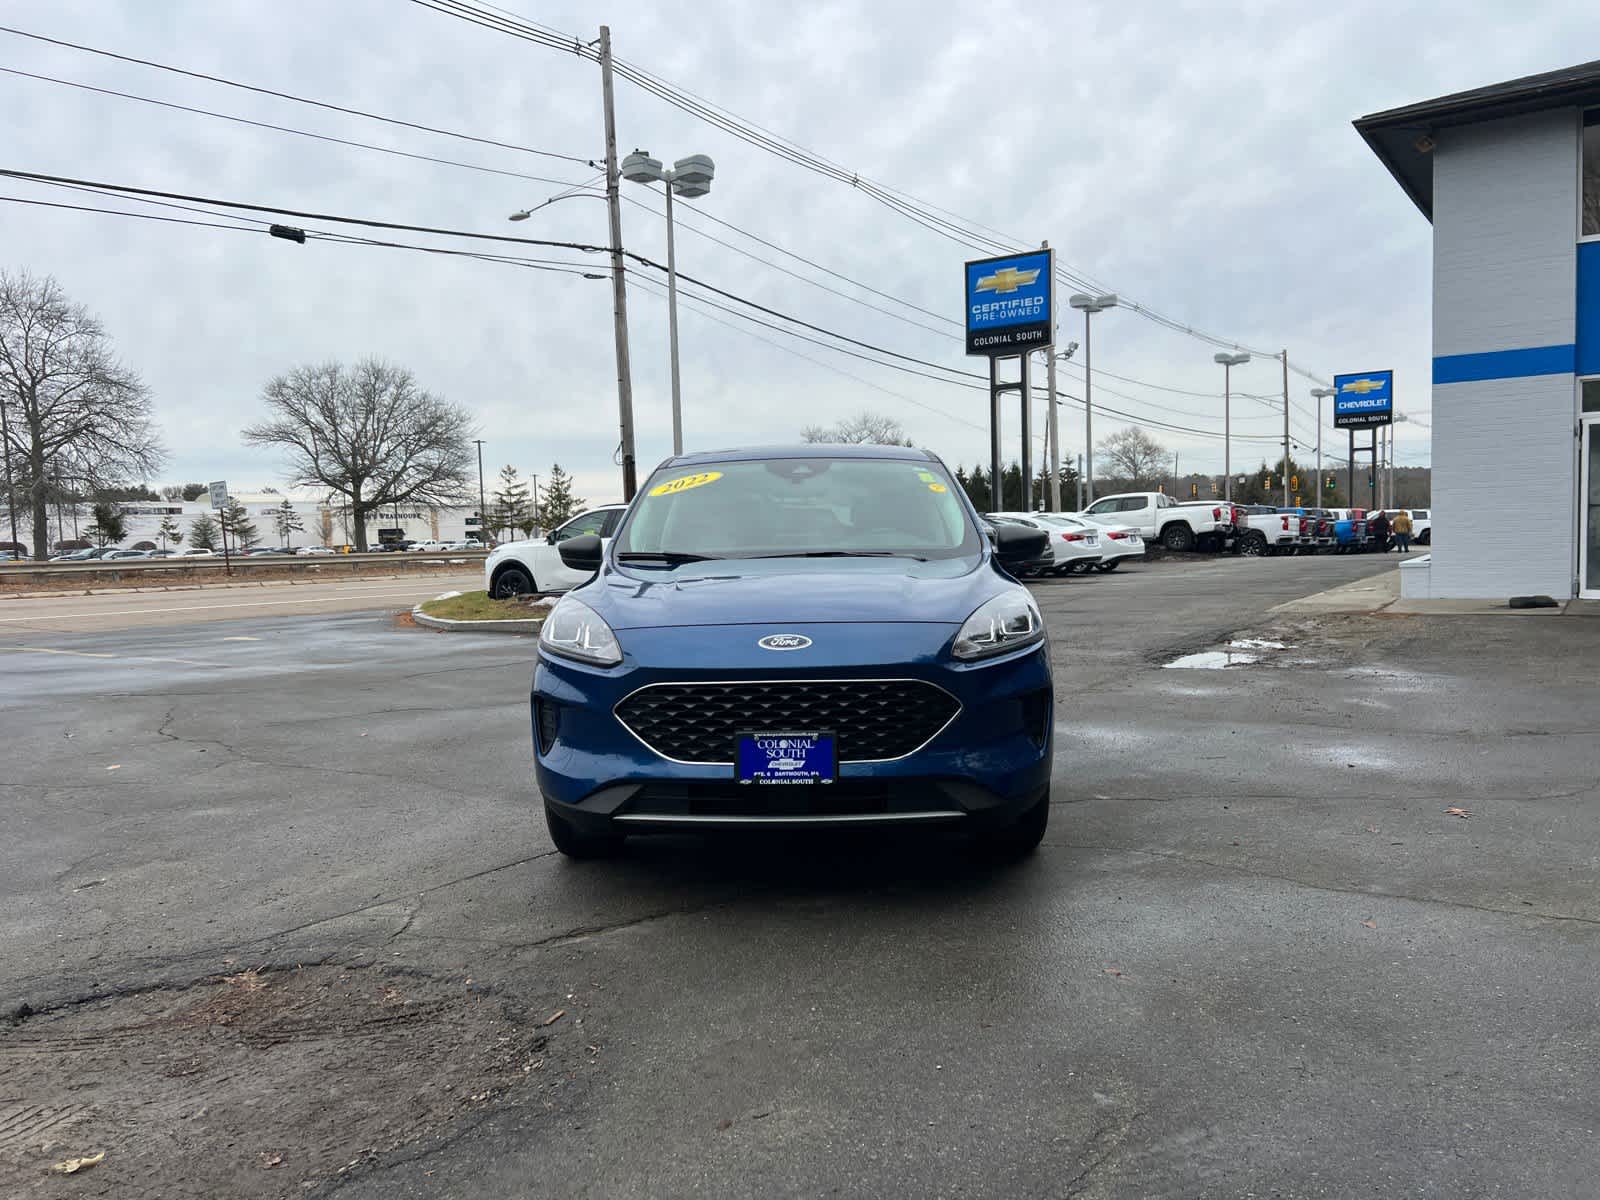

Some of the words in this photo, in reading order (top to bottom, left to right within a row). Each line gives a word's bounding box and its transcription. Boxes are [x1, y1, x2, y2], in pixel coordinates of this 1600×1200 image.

[972, 296, 1044, 314] CERTIFIED
[975, 305, 1040, 322] PRE-OWNED
[974, 334, 1012, 346] COLONIAL
[1016, 330, 1042, 341] SOUTH
[1338, 399, 1388, 409] CHEVROLET
[1338, 416, 1366, 424] COLONIAL
[661, 474, 709, 493] 2022
[770, 636, 800, 646] Ford
[757, 740, 815, 750] COLONIAL
[766, 749, 806, 759] SOUTH
